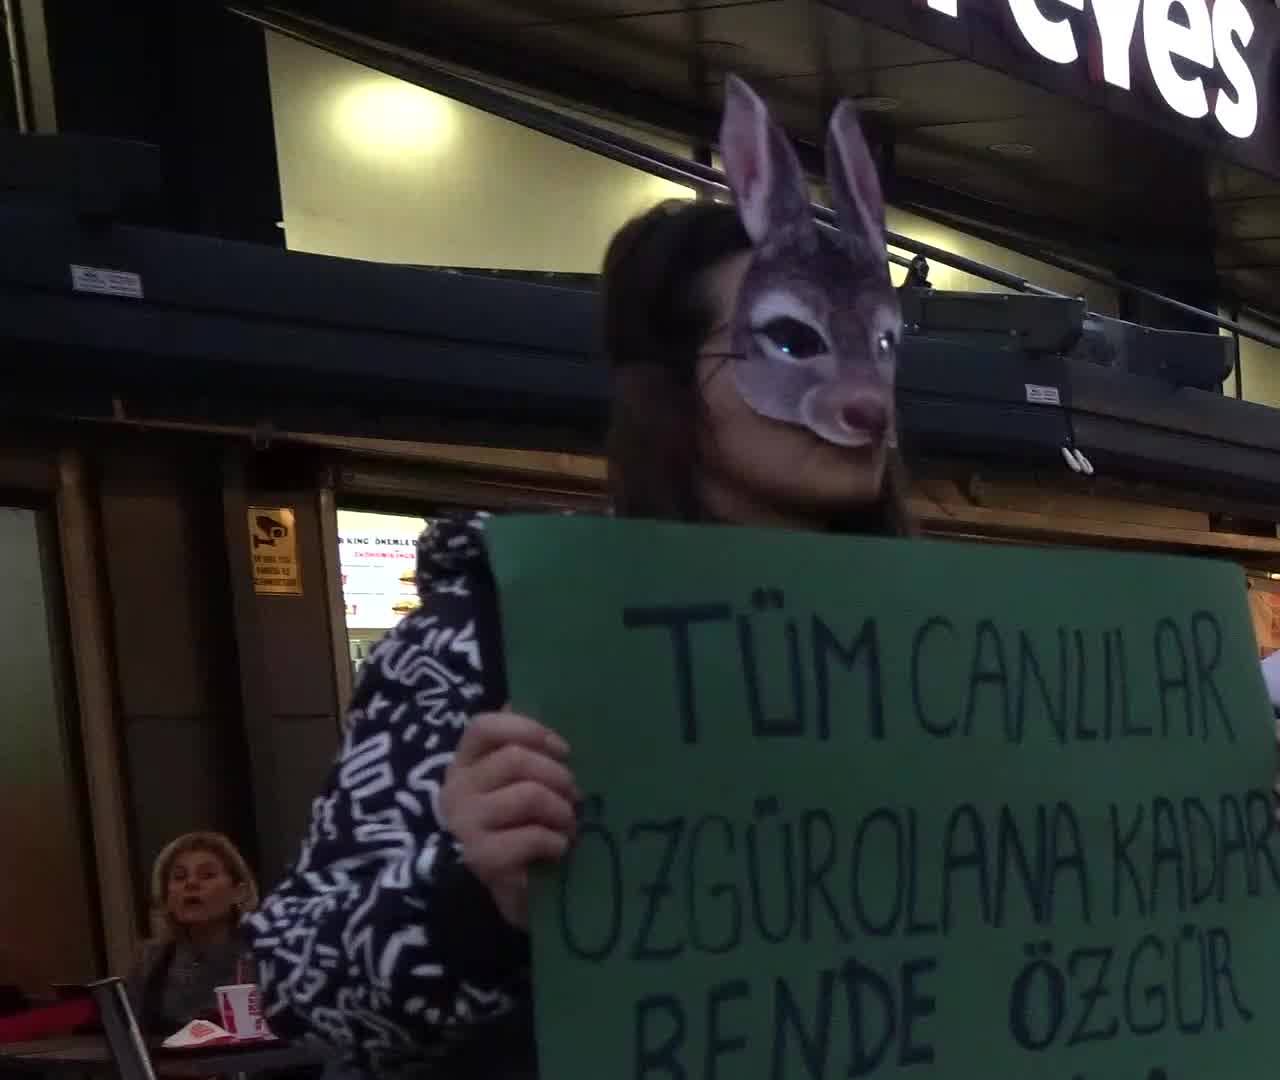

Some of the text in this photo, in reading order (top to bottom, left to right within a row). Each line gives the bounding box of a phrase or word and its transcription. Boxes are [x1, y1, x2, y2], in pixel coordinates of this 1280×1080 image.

[624, 587, 1238, 746] TÜM CANLILAR
[1007, 924, 1255, 1053] ÖZGÜR
